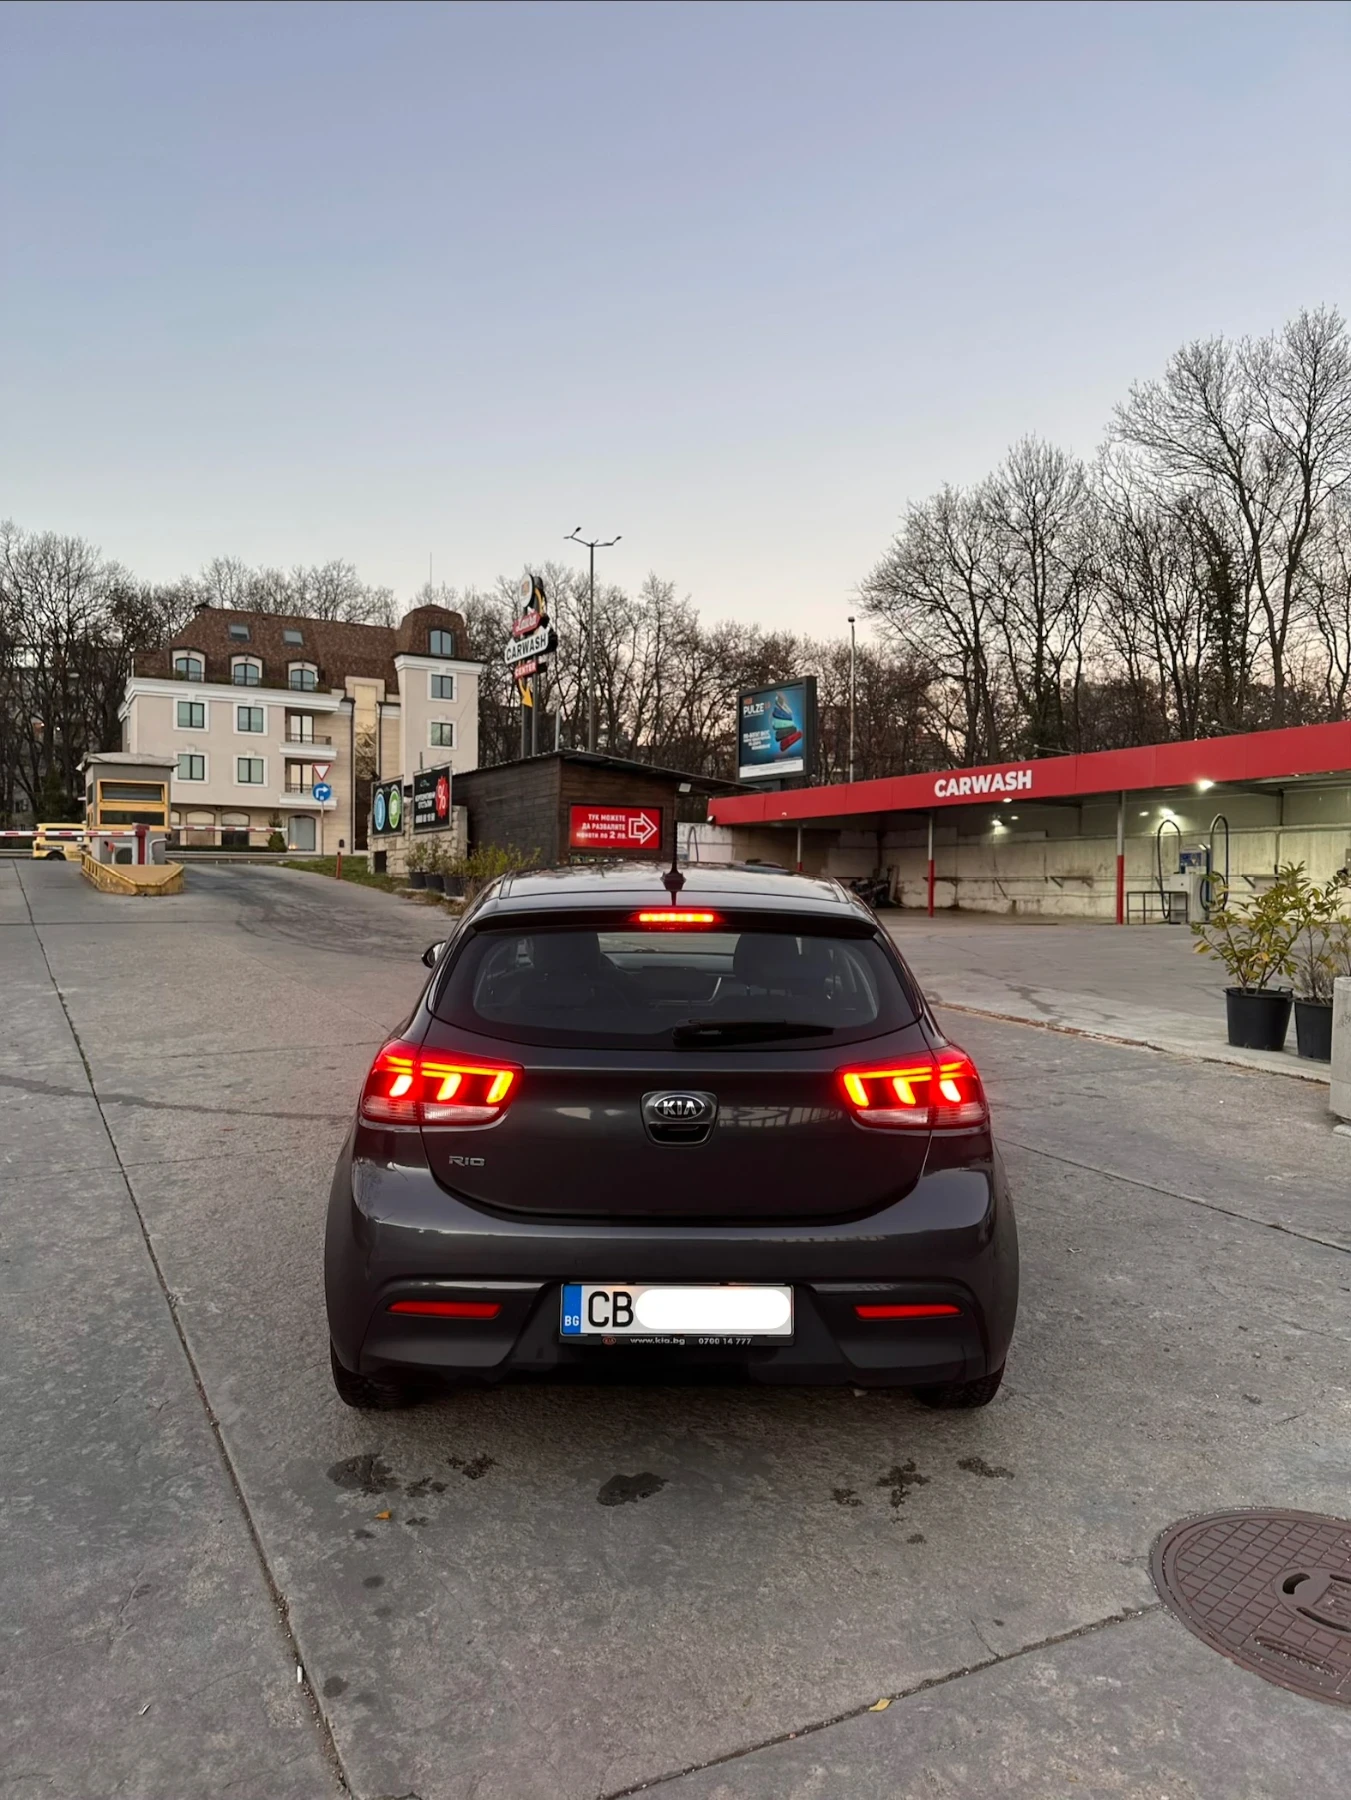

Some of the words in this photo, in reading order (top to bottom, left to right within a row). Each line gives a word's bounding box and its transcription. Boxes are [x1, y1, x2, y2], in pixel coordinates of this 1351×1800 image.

[506, 634, 547, 661] CARWASH
[515, 662, 537, 677] CENTER
[743, 703, 764, 715] PULZE
[934, 769, 1032, 797] CARWASH
[588, 813, 599, 821] ТУК
[600, 814, 626, 822] МОЖЕТЕ
[581, 822, 591, 831] ДА
[592, 823, 626, 831] РАЗВАЛИТЕ
[609, 831, 616, 839] 2
[662, 1100, 697, 1115] KIA
[449, 1155, 485, 1167] RIO
[564, 1315, 580, 1326] BG
[630, 1337, 686, 1346] www.kia.bg
[699, 1337, 719, 1346] 0700
[723, 1337, 733, 1345] 14
[735, 1337, 752, 1345] 777
